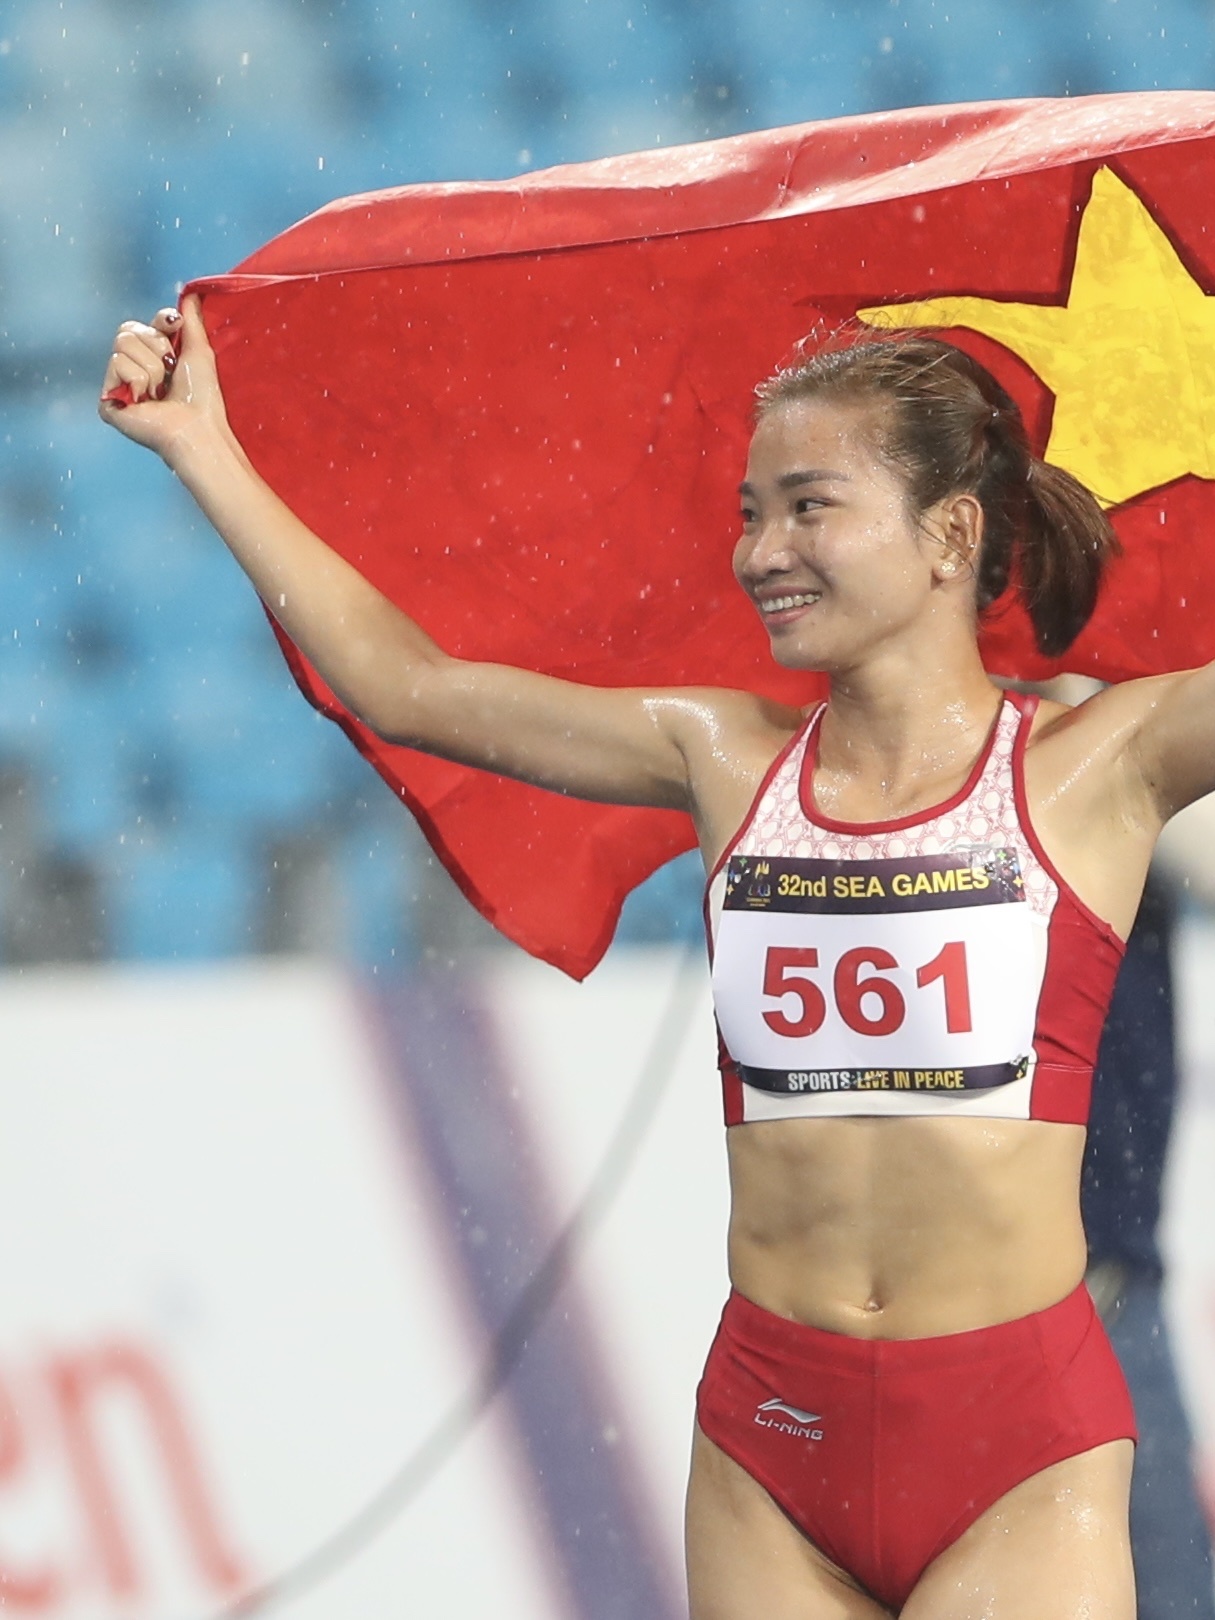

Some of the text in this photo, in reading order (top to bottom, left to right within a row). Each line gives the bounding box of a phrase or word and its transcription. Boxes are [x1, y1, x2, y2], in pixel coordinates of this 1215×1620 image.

[777, 866, 990, 898] 32nd SEA GAMES
[761, 940, 972, 1038] 561
[893, 1071, 911, 1089] IN
[914, 1070, 965, 1089] PEACE
[754, 1412, 824, 1441] LI-NING
